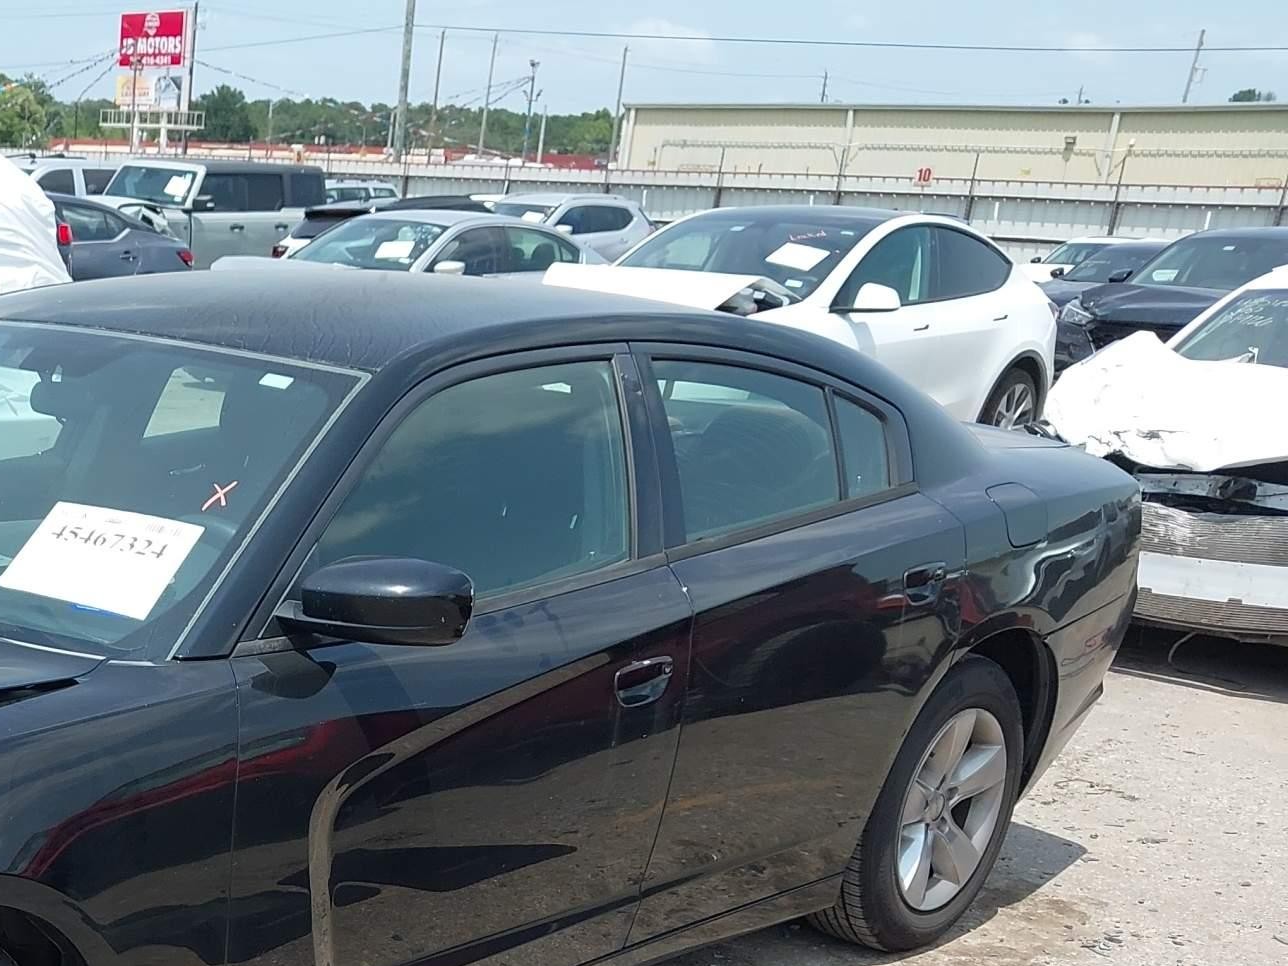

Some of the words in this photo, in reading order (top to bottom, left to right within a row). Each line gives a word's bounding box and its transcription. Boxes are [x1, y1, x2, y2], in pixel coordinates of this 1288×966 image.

[137, 36, 180, 54] MOTORS
[918, 167, 932, 182] 10
[51, 525, 169, 559] 45467324
